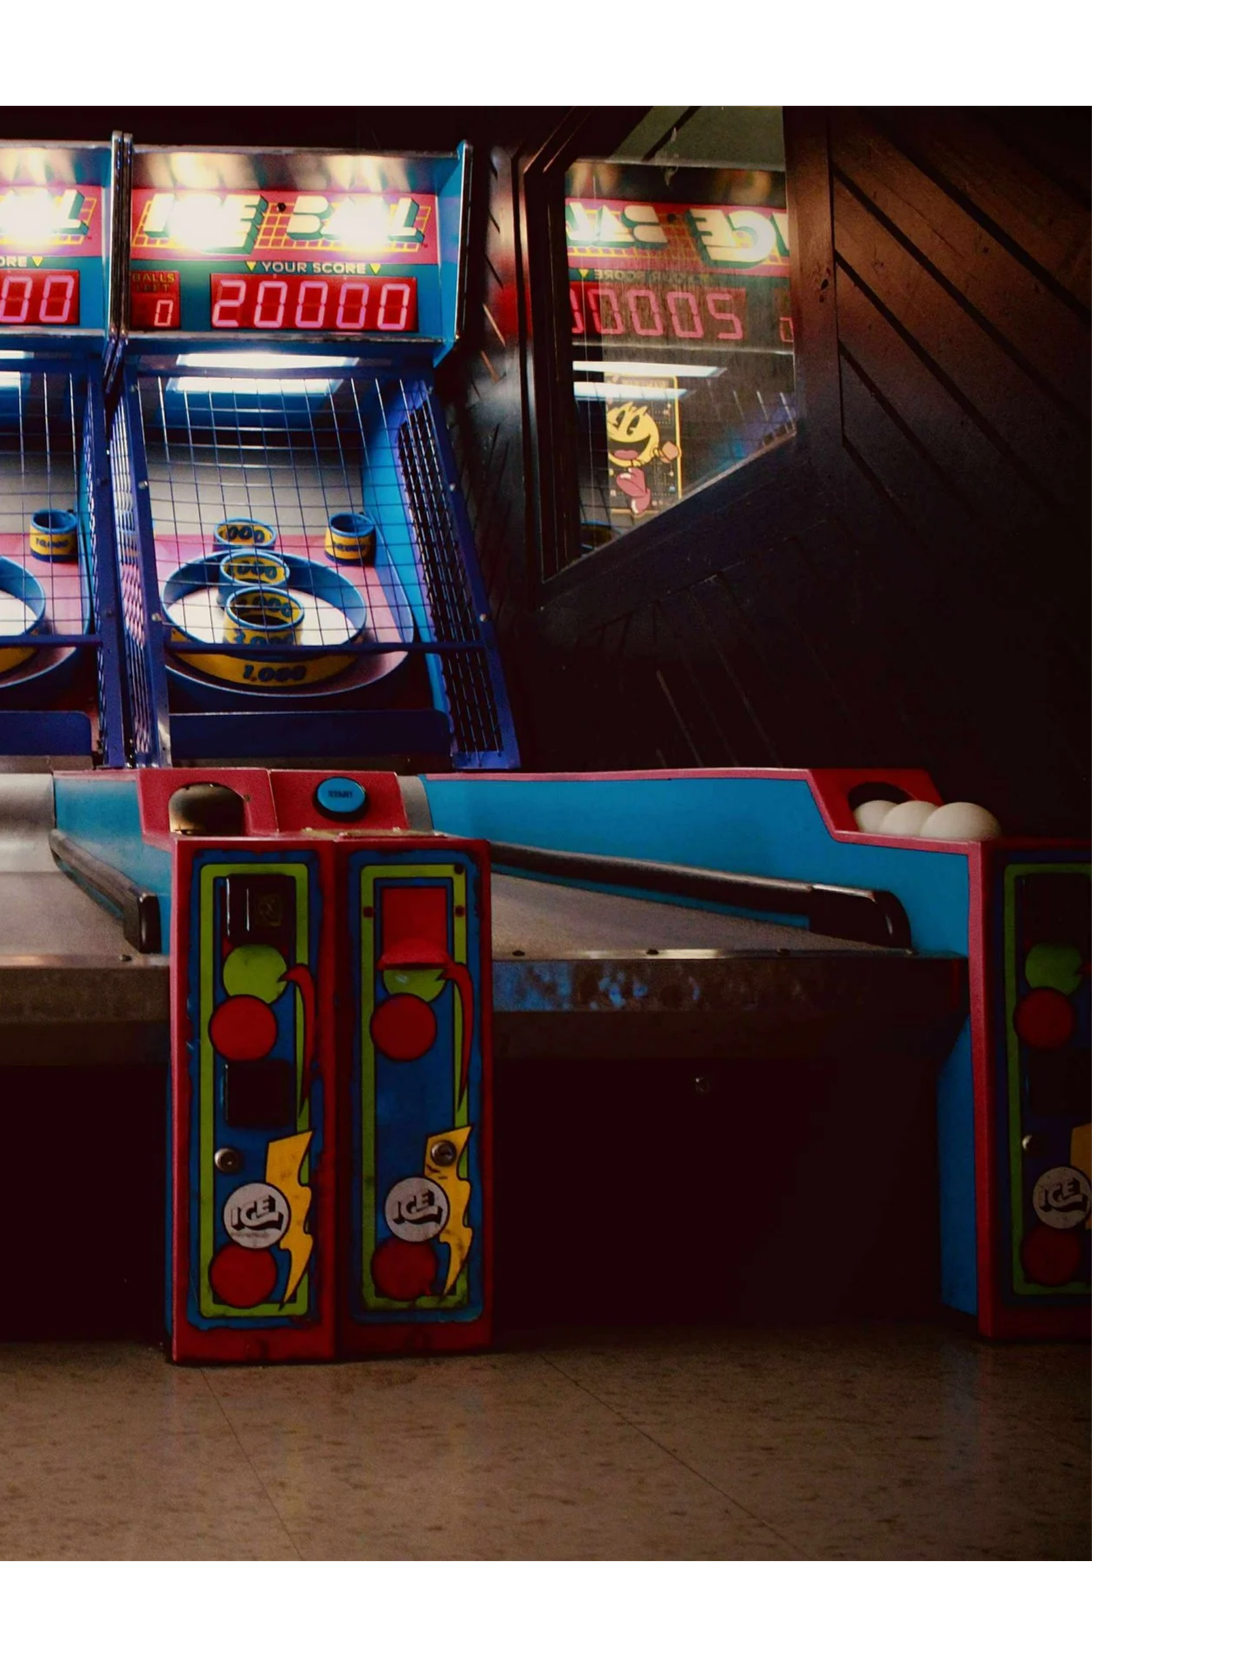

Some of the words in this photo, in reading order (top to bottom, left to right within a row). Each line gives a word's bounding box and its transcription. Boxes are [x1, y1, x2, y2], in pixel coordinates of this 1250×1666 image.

[143, 193, 269, 255] IE
[286, 194, 425, 244] BL
[131, 273, 175, 282] BALLS
[261, 260, 307, 273] YOUR
[312, 261, 366, 275] SCORE
[153, 299, 174, 327] 0
[211, 279, 411, 329] 20000
[392, 1189, 443, 1224] ICE
[1036, 1178, 1088, 1212] ICE
[231, 1195, 284, 1231] ICE
